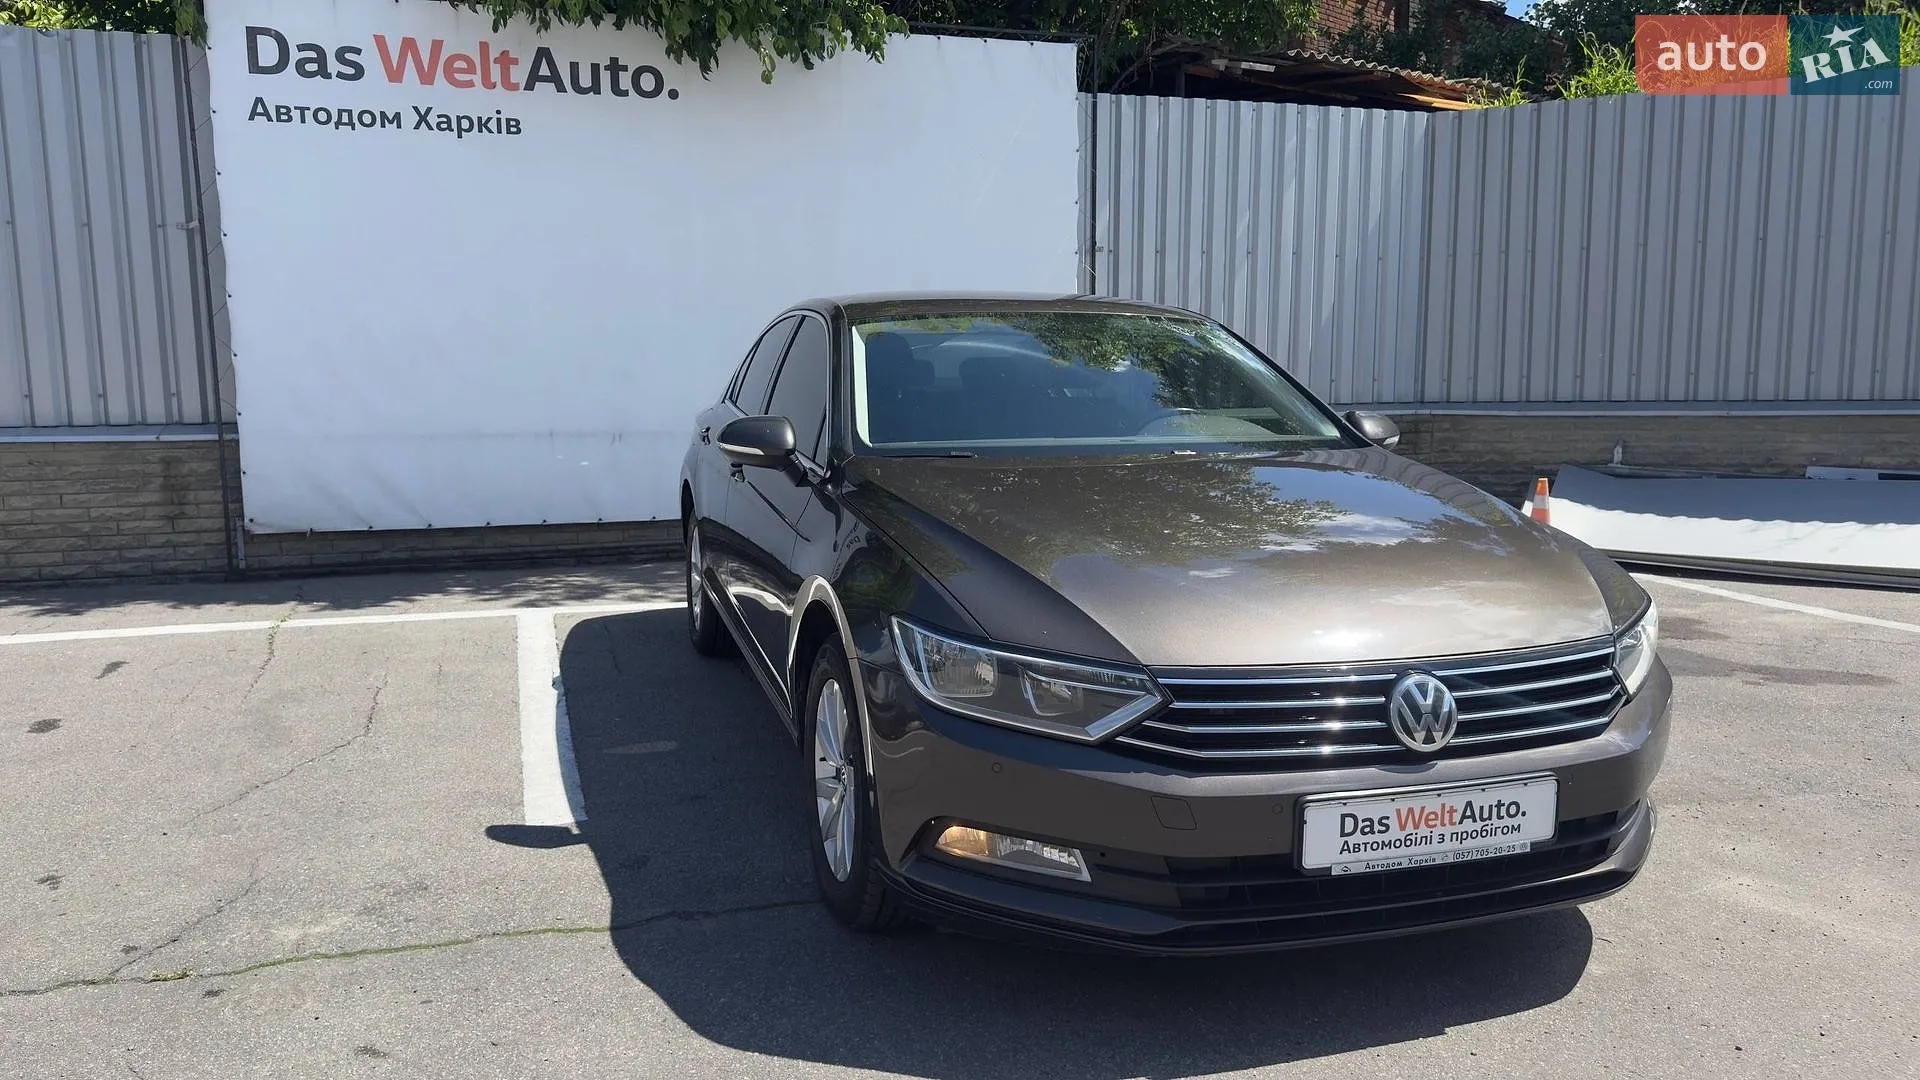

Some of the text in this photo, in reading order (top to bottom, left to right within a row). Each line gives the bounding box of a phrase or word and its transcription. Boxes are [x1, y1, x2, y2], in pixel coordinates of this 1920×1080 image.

[245, 25, 365, 82] Das
[248, 96, 522, 140] Автодом Харків
[1339, 812, 1391, 838] Das
[1339, 822, 1522, 855] Автомобілі з пробігом
[1364, 860, 1403, 871] Автодом
[1407, 855, 1437, 867] Харків
